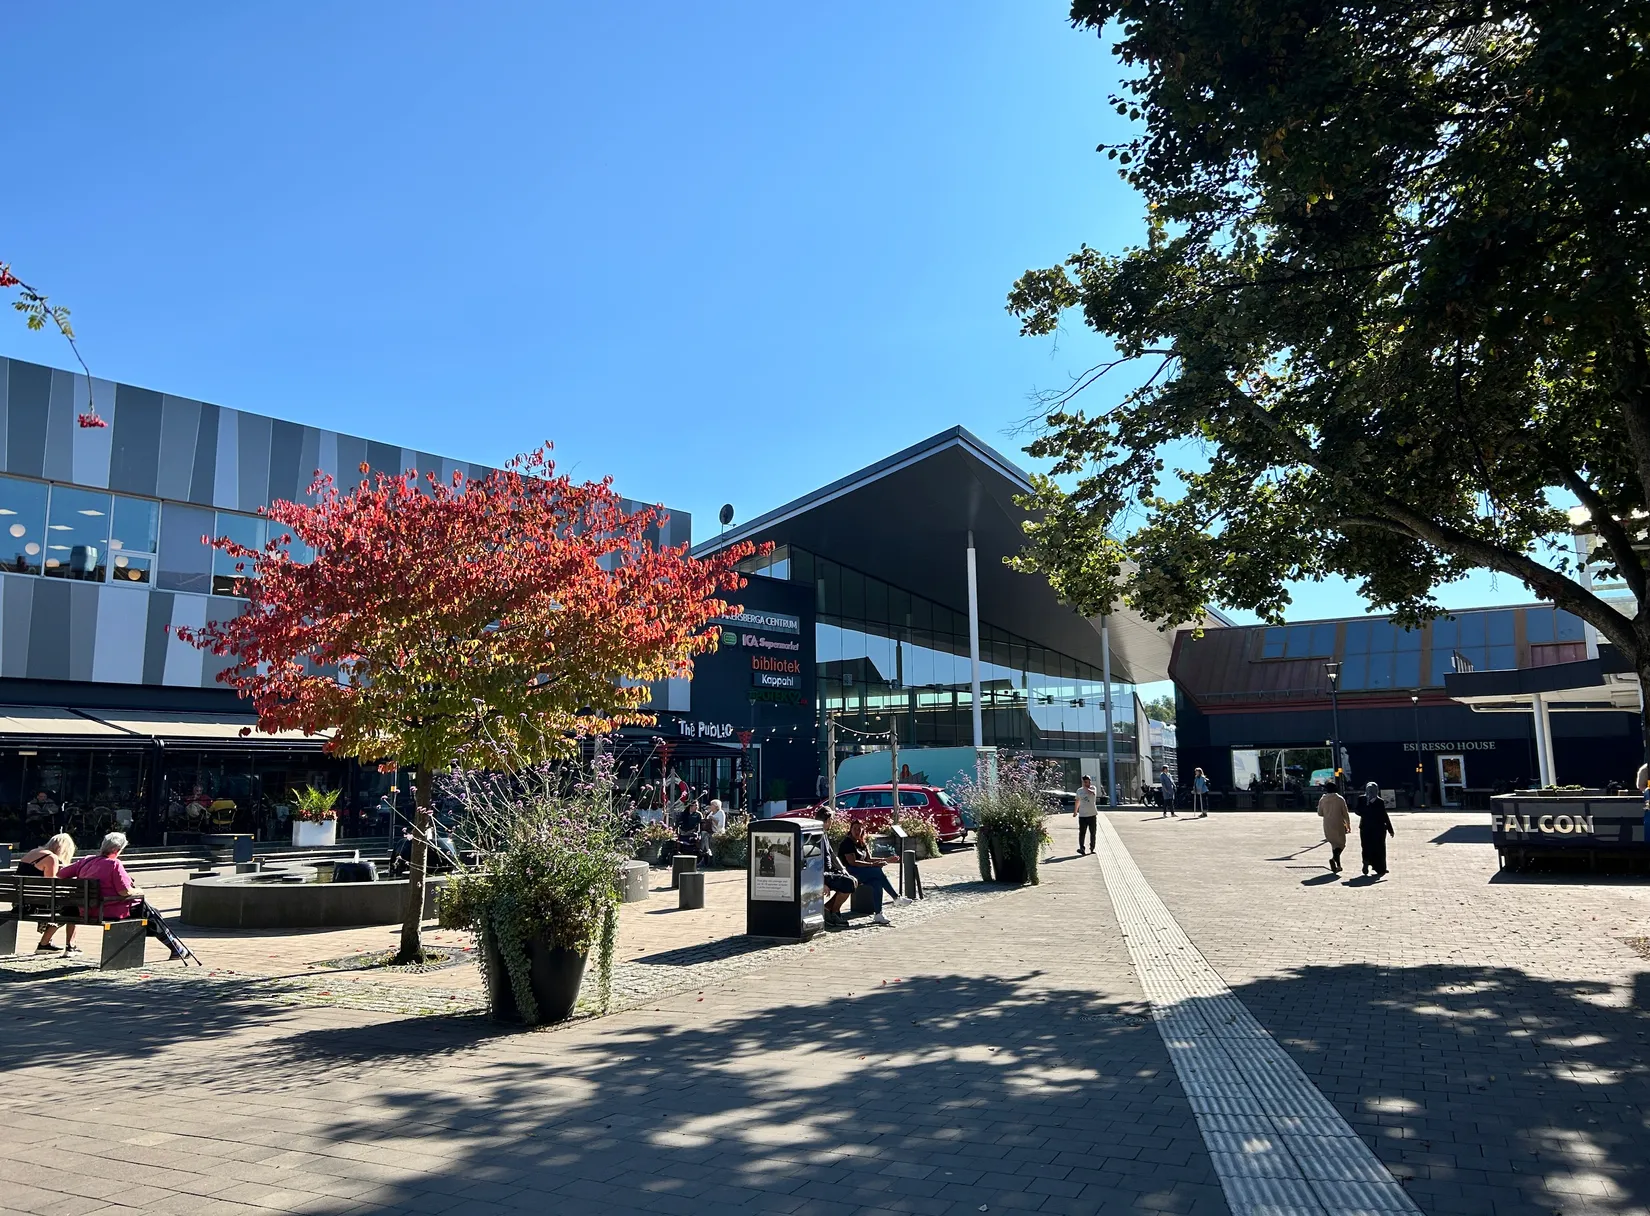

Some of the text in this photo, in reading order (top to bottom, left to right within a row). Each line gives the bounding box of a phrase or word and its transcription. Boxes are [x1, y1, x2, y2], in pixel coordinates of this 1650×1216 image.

[766, 616, 798, 629] CENTRUM
[742, 633, 759, 648] ICA
[759, 637, 799, 651] Supermarket
[752, 655, 800, 673] bibliotek
[761, 673, 794, 687] Kappahl
[1457, 741, 1496, 750] HOUSE
[1491, 815, 1595, 833] FALCON
